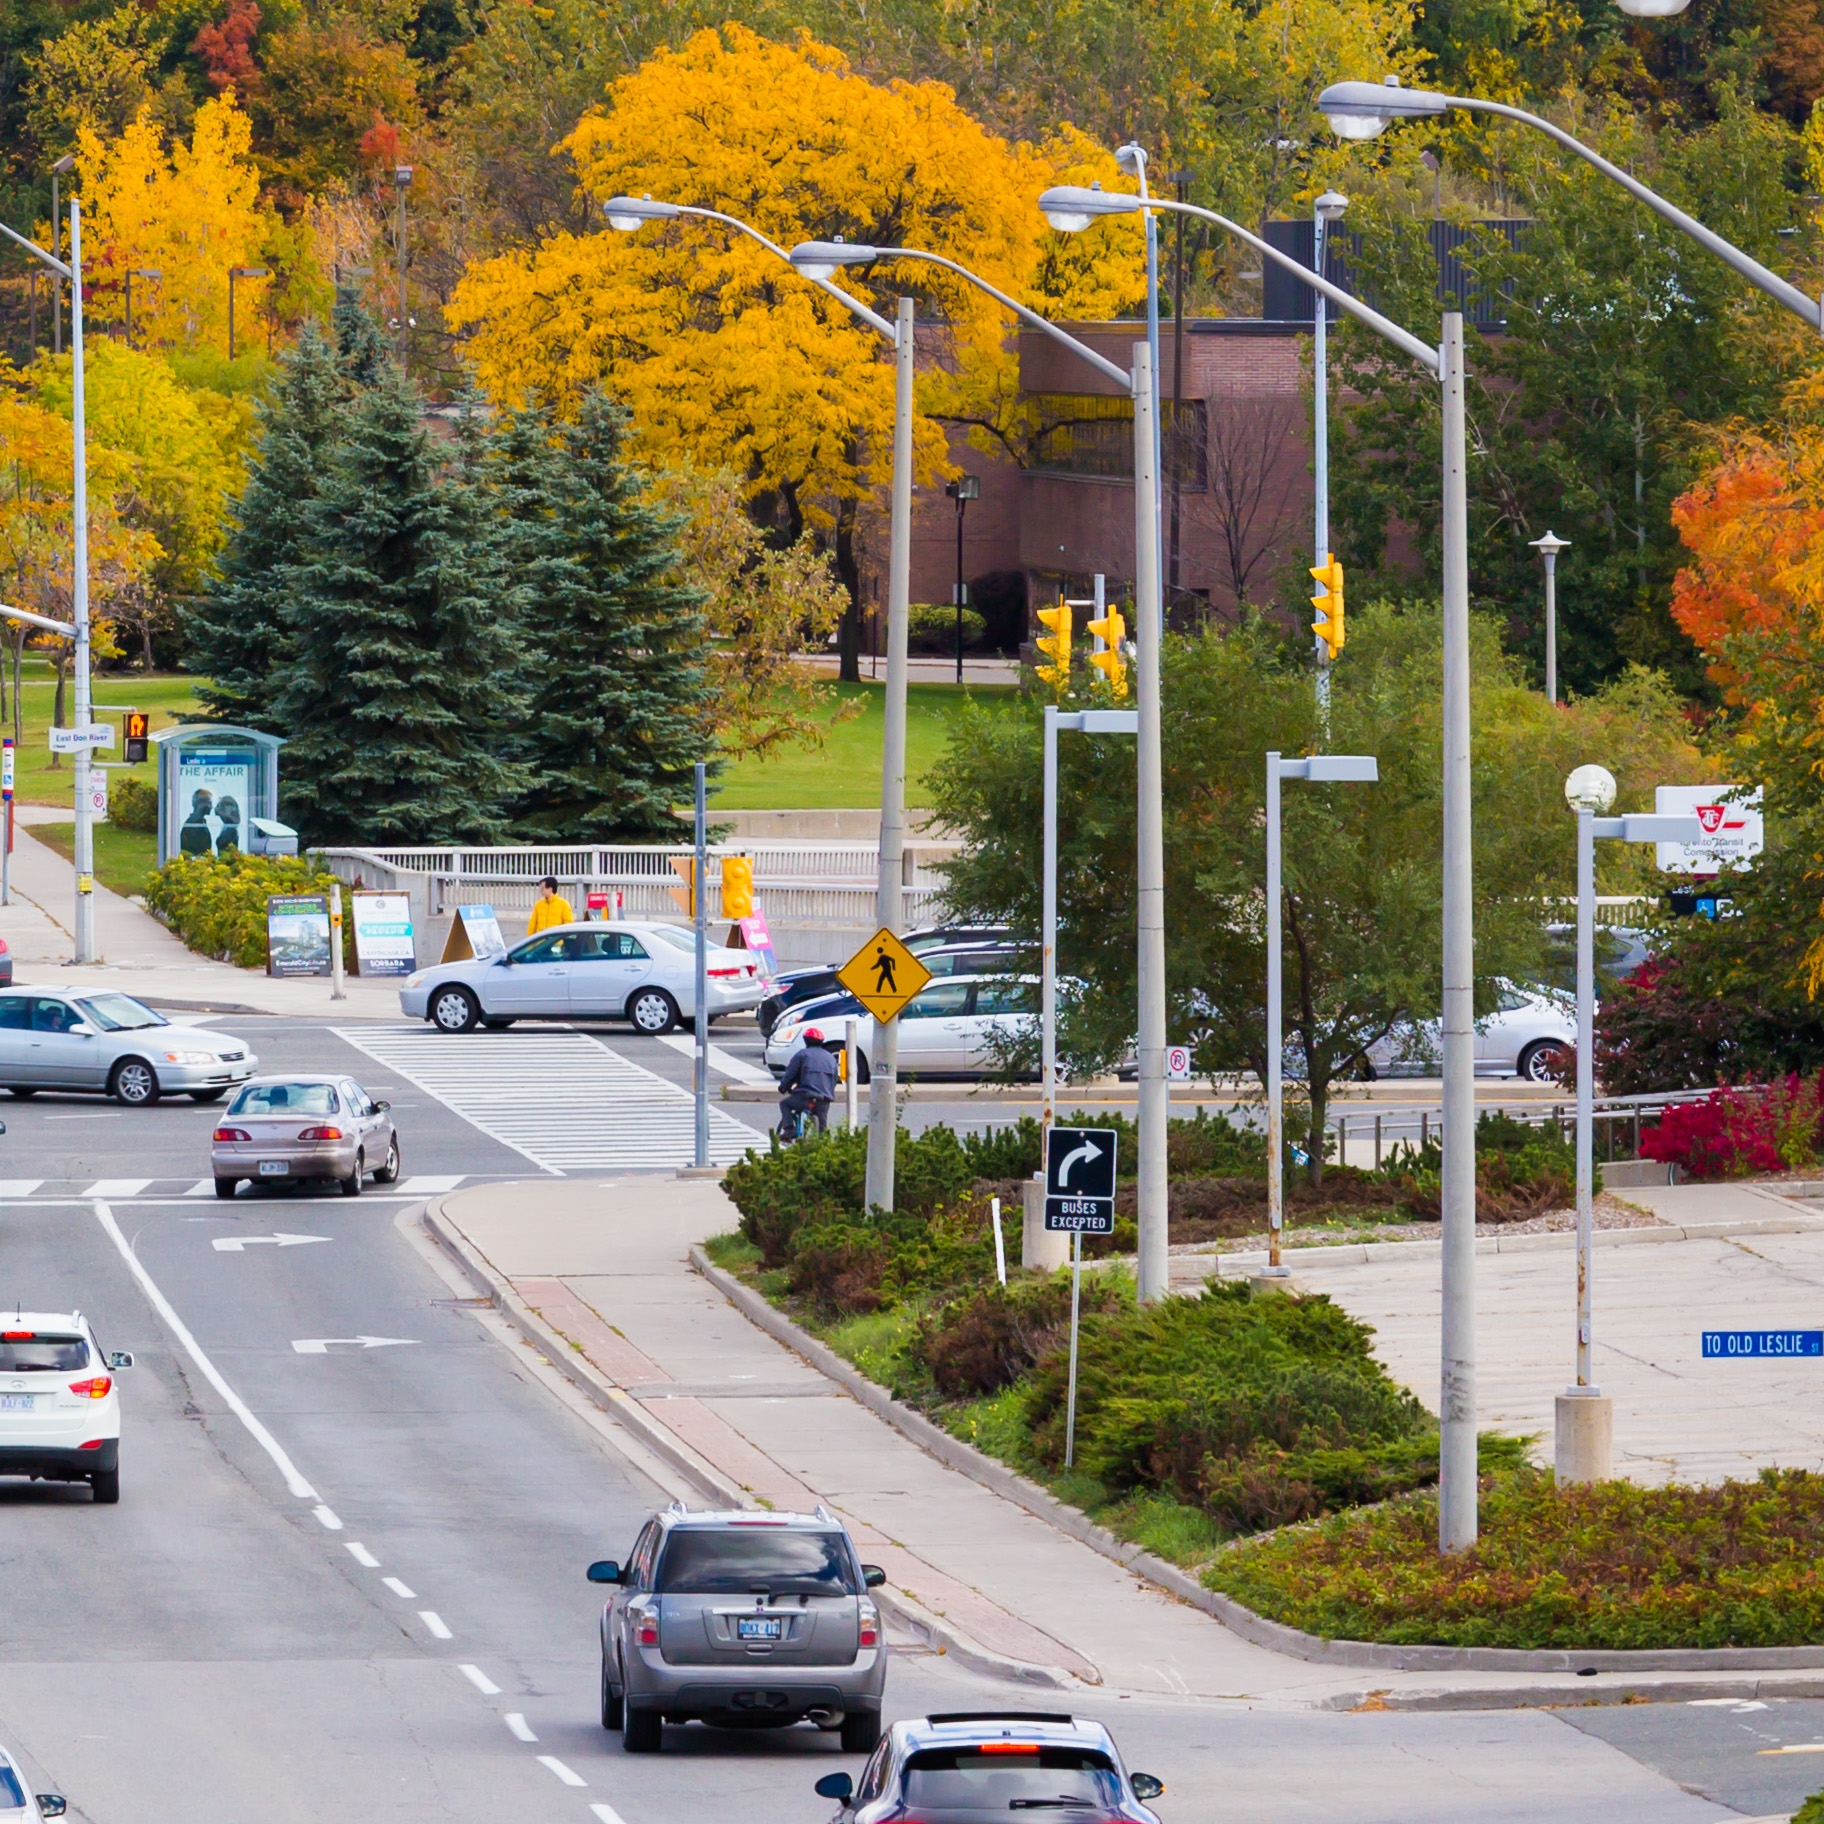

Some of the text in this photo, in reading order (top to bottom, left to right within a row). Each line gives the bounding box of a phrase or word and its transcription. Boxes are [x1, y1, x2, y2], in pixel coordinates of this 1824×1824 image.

[56, 734, 71, 742] East
[73, 734, 88, 742] Don
[179, 767, 244, 776] THE AFFAIR
[1061, 1202, 1097, 1214] BUSES
[1051, 1216, 1106, 1230] EXCEPTED
[1706, 1334, 1819, 1354] TO OLD LESLIE ST
